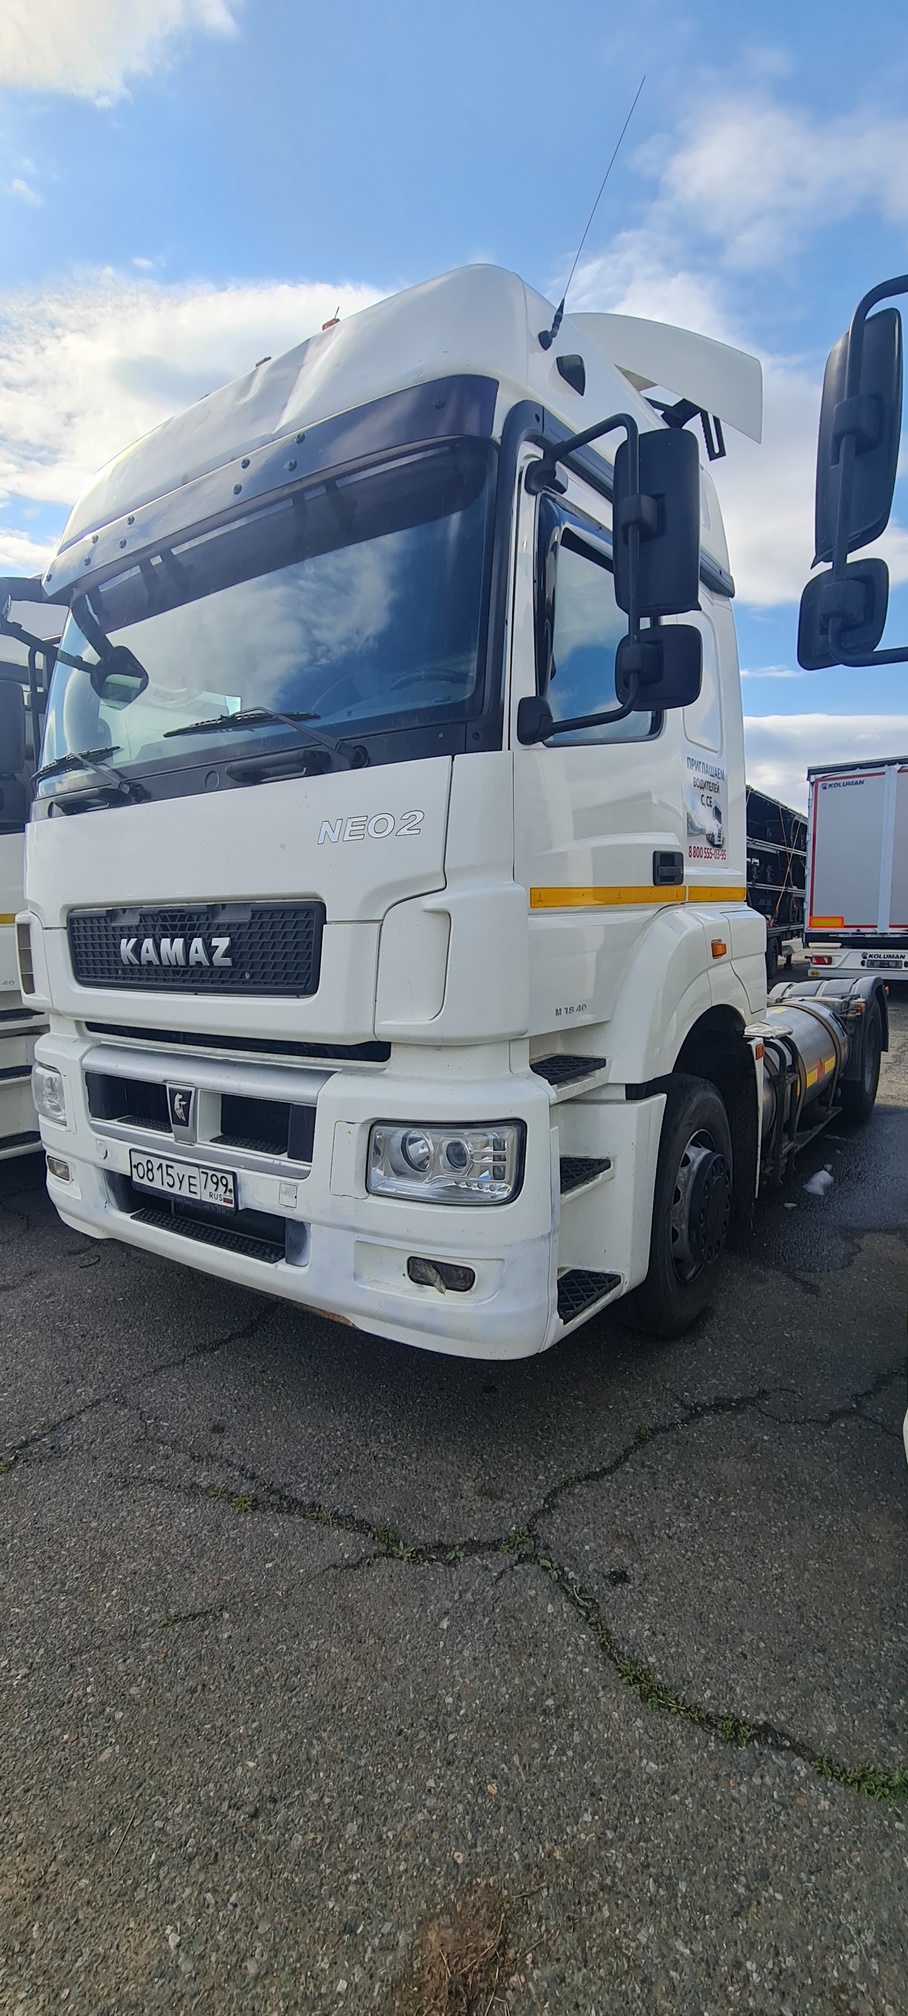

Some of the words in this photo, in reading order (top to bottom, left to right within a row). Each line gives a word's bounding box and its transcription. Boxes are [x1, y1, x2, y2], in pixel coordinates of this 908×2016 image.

[686, 756, 725, 781] ПРИГЛАШАЕМ
[693, 777, 720, 794] ВОДИТЕЛЕЙ
[828, 780, 865, 789] KOLUMAN
[317, 809, 425, 845] NEO2
[688, 845, 692, 858] 8
[120, 937, 232, 966] KAMAZ
[201, 1171, 229, 1194] 799
[208, 1191, 223, 1202] RUS
